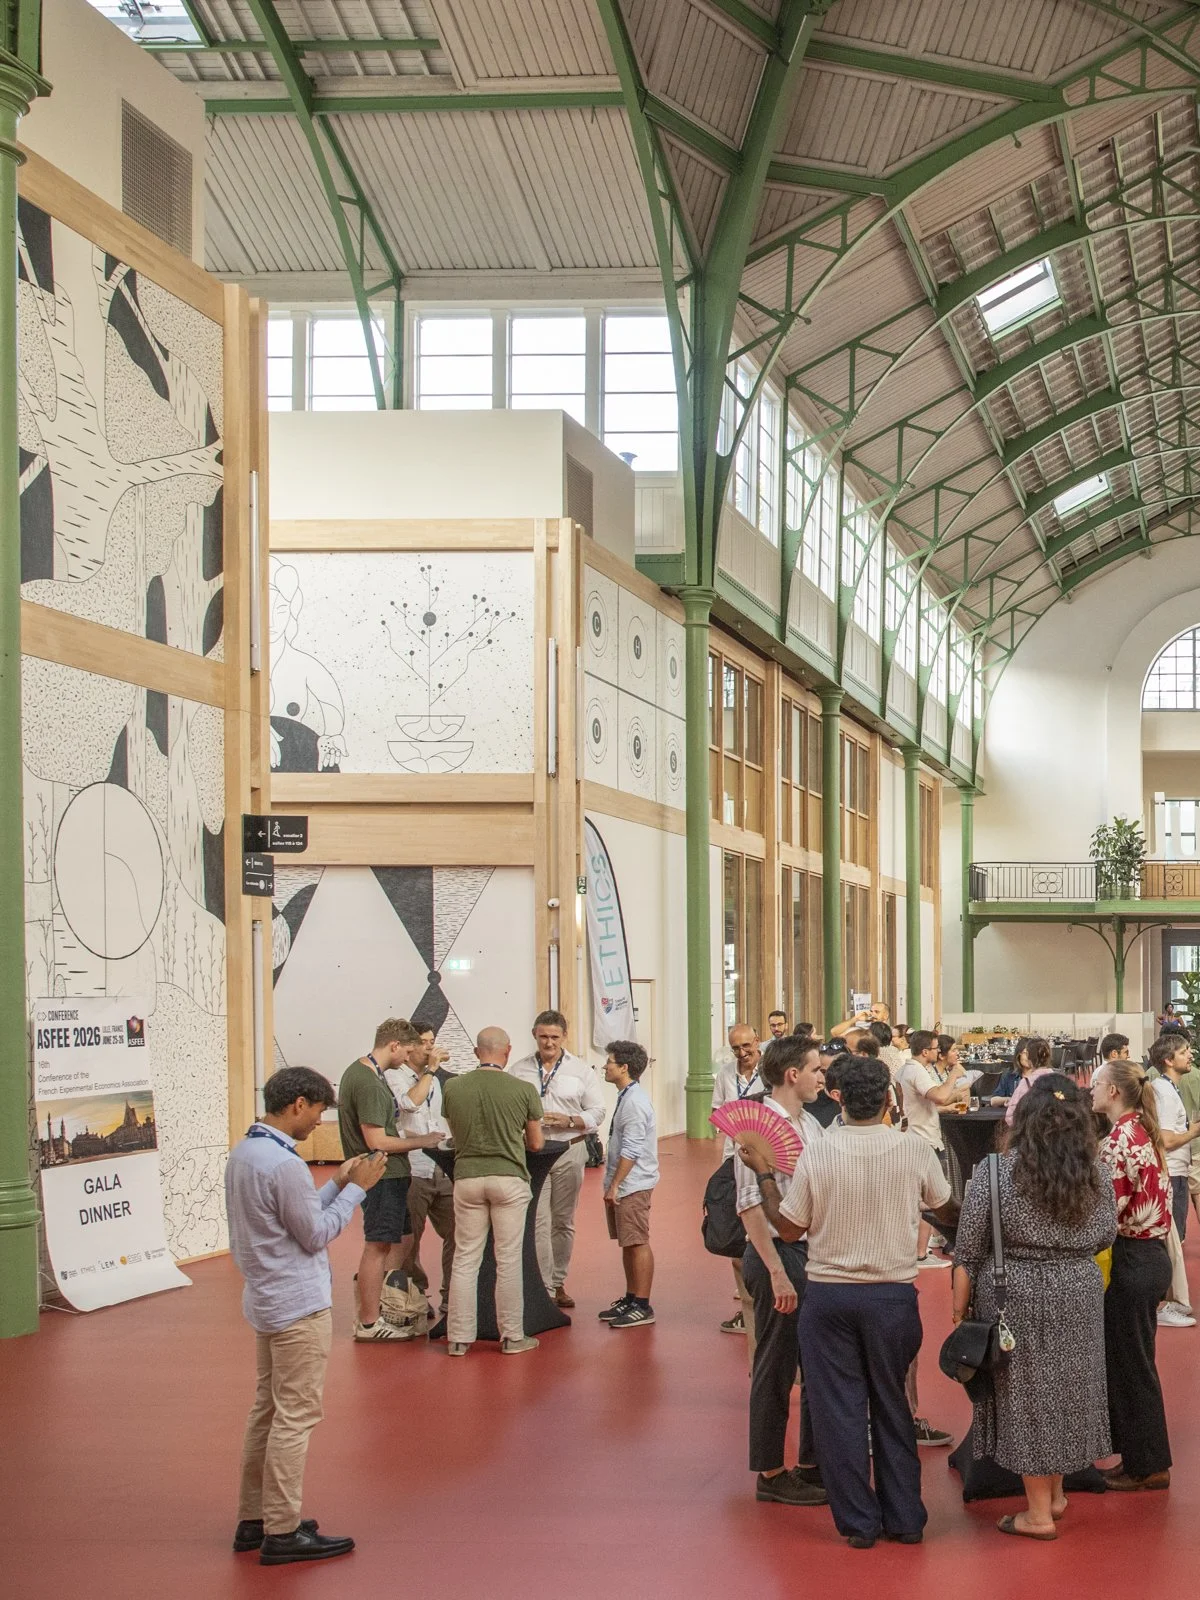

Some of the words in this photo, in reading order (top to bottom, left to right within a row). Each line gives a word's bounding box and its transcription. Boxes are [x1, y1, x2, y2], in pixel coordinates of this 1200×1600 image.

[591, 854, 624, 987] ETHICS
[48, 1010, 79, 1021] CONFERENCE
[37, 1028, 70, 1049] ASFEE
[73, 1026, 101, 1047] 2026
[128, 1037, 144, 1046] ASFEE
[38, 1073, 72, 1083] Conference
[73, 1071, 80, 1080] of
[80, 1071, 89, 1079] the
[38, 1087, 58, 1095] French
[59, 1083, 93, 1094] Experimental
[94, 1082, 121, 1091] Economics
[121, 1079, 148, 1088] Association
[727, 1106, 760, 1125] PUTAIN
[84, 1173, 122, 1195] GALA
[79, 1200, 132, 1225] DINNER
